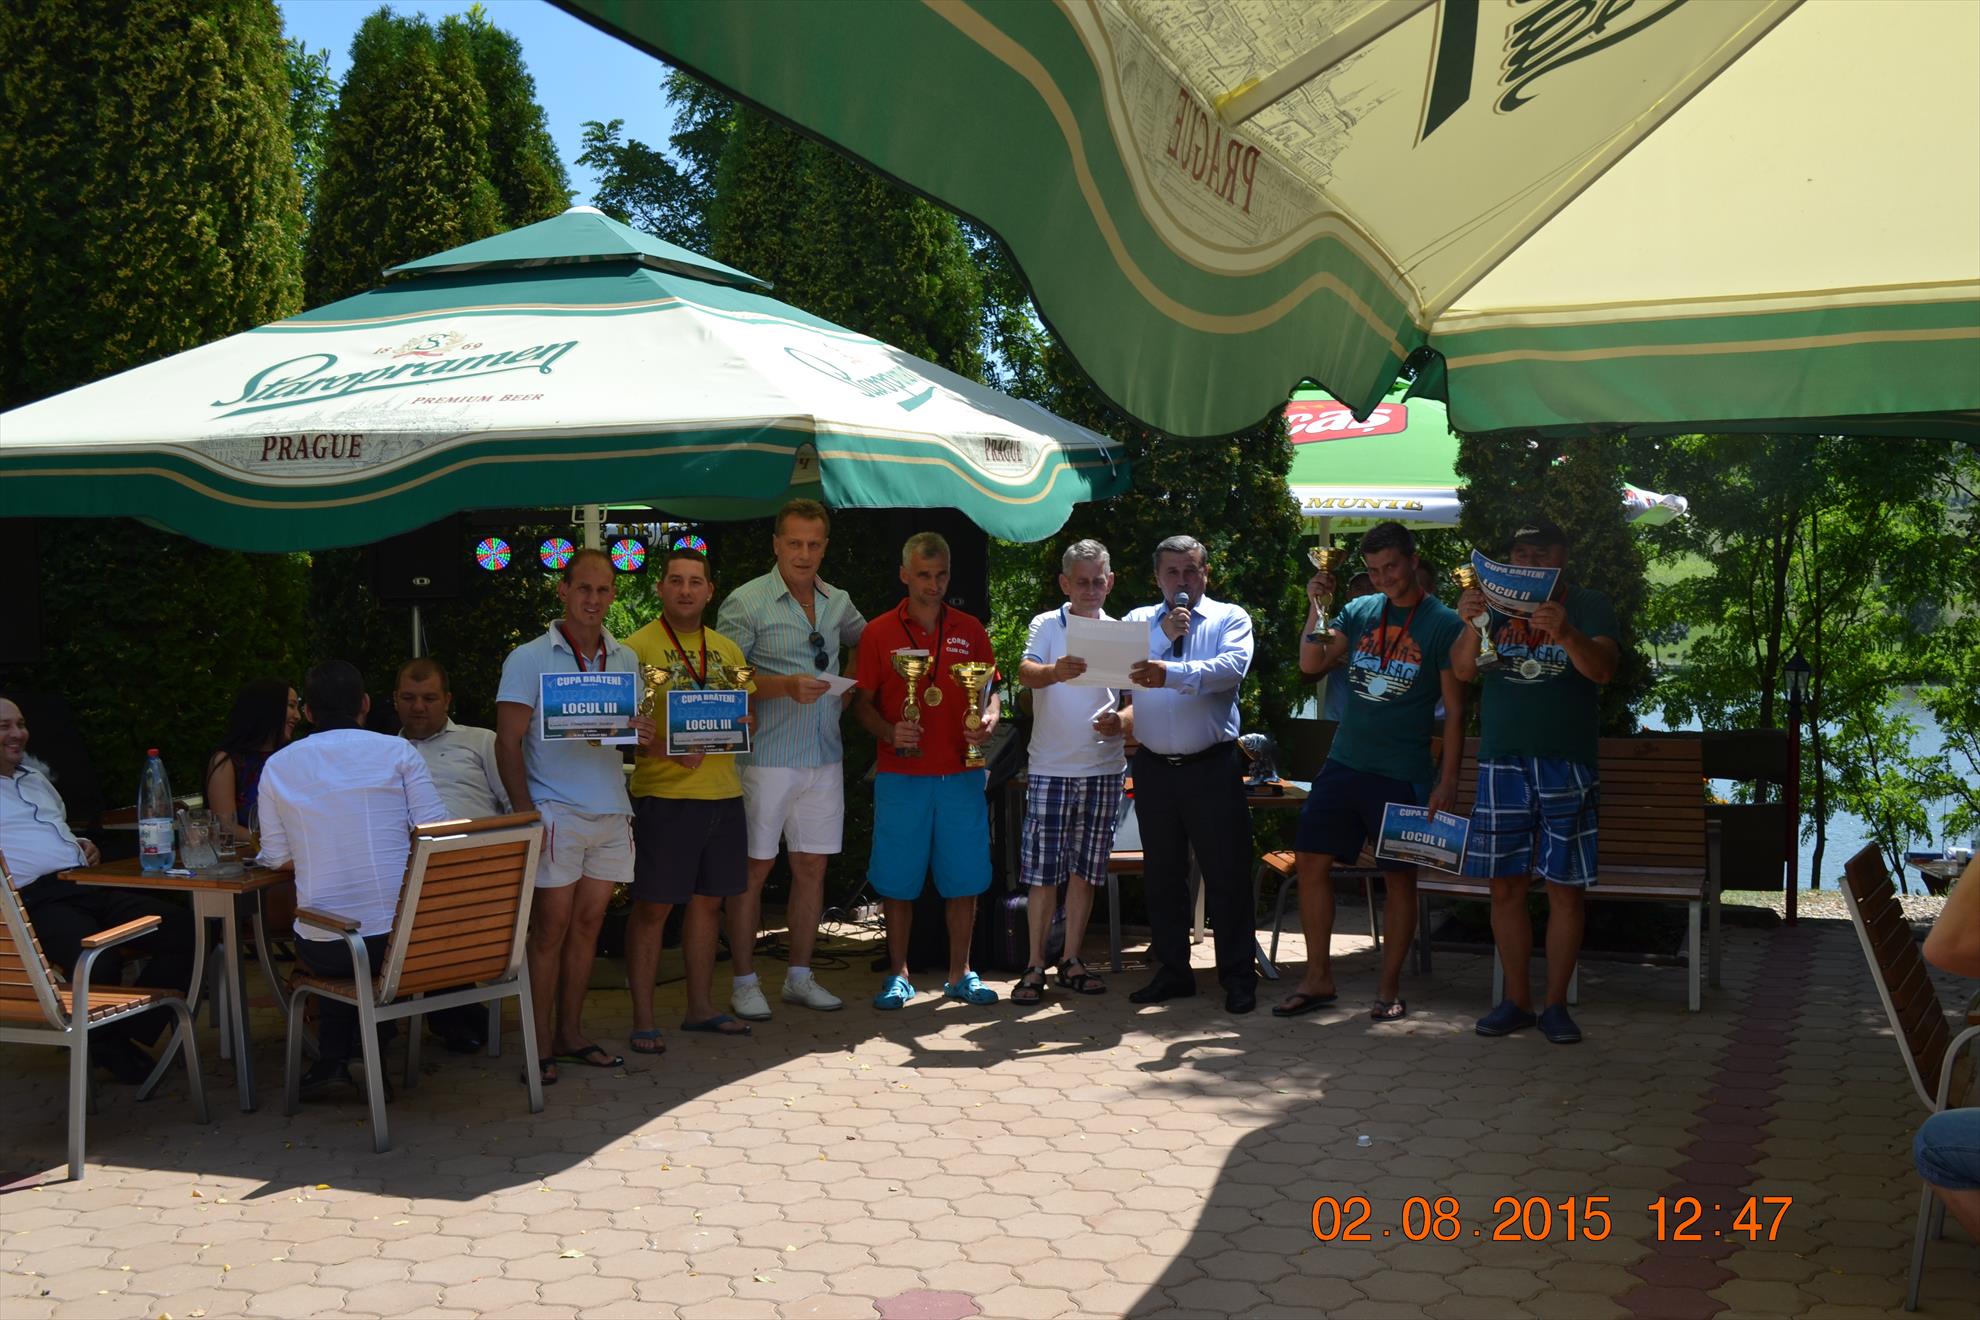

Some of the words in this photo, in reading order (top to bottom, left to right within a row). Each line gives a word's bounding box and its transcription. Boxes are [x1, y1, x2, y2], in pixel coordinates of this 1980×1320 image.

[210, 340, 579, 420] Staropramen
[411, 395, 494, 405] PREMIUM
[498, 393, 544, 402] BEER
[260, 434, 363, 462] PRAGUE
[984, 437, 1023, 462] PRAGUE
[1304, 497, 1423, 511] MUNTE
[1484, 562, 1507, 574] CUPA
[1483, 579, 1519, 600] LOCUL
[1520, 591, 1531, 601] II
[557, 676, 582, 686] CUPA
[681, 694, 702, 704] CUPA
[562, 702, 602, 714] LOCUL
[604, 702, 617, 714] III
[686, 719, 719, 730] LOCUL
[721, 719, 732, 730] III
[1400, 808, 1421, 816] CUPA
[1401, 830, 1436, 846] LOCUL
[1437, 838, 1447, 848] II
